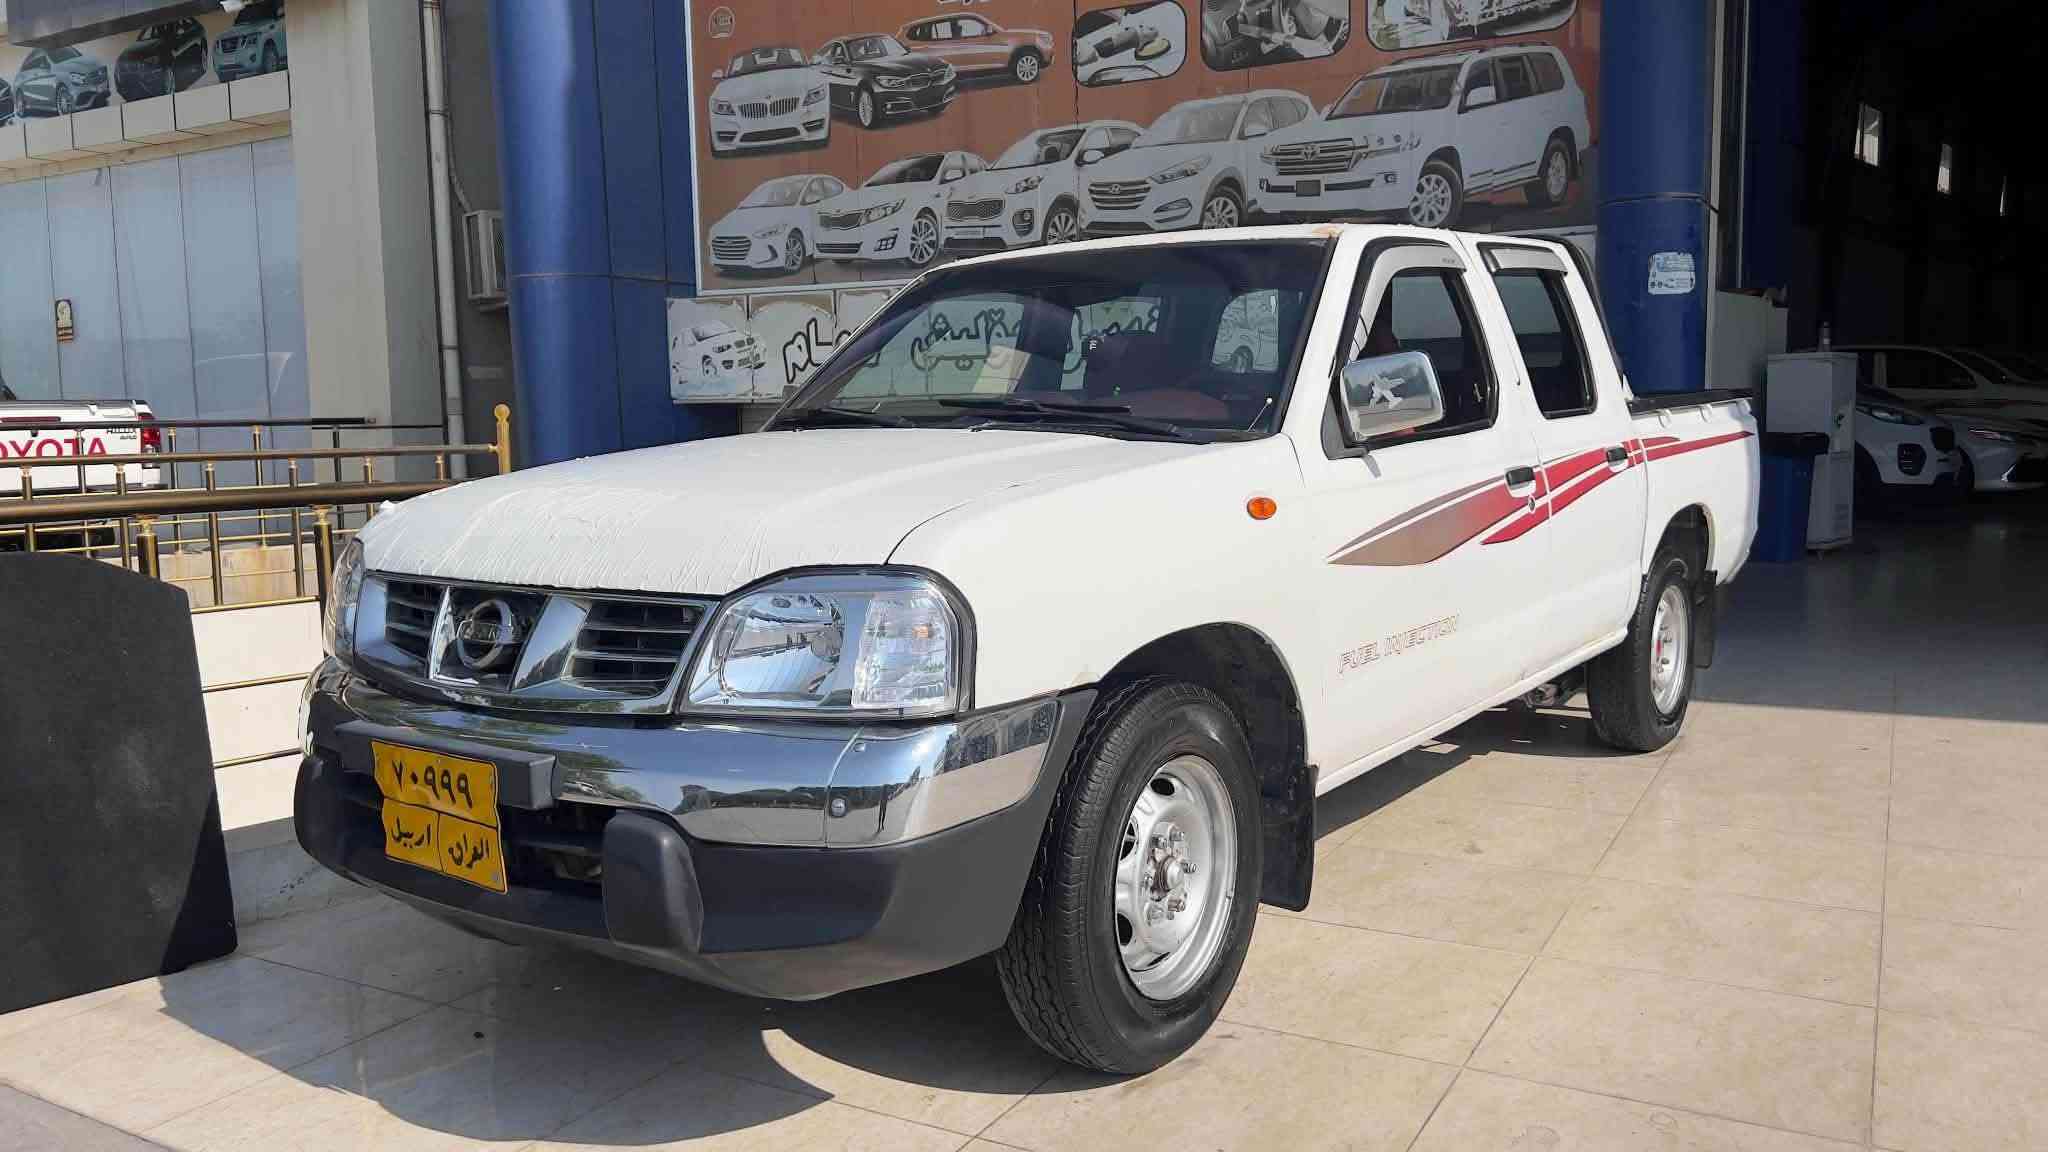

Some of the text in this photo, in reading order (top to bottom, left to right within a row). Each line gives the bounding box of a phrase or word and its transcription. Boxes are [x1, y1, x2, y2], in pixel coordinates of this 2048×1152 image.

[1337, 614, 1457, 674] FUEL INJECTION
[392, 759, 474, 809] ٧٠٩٩٩
